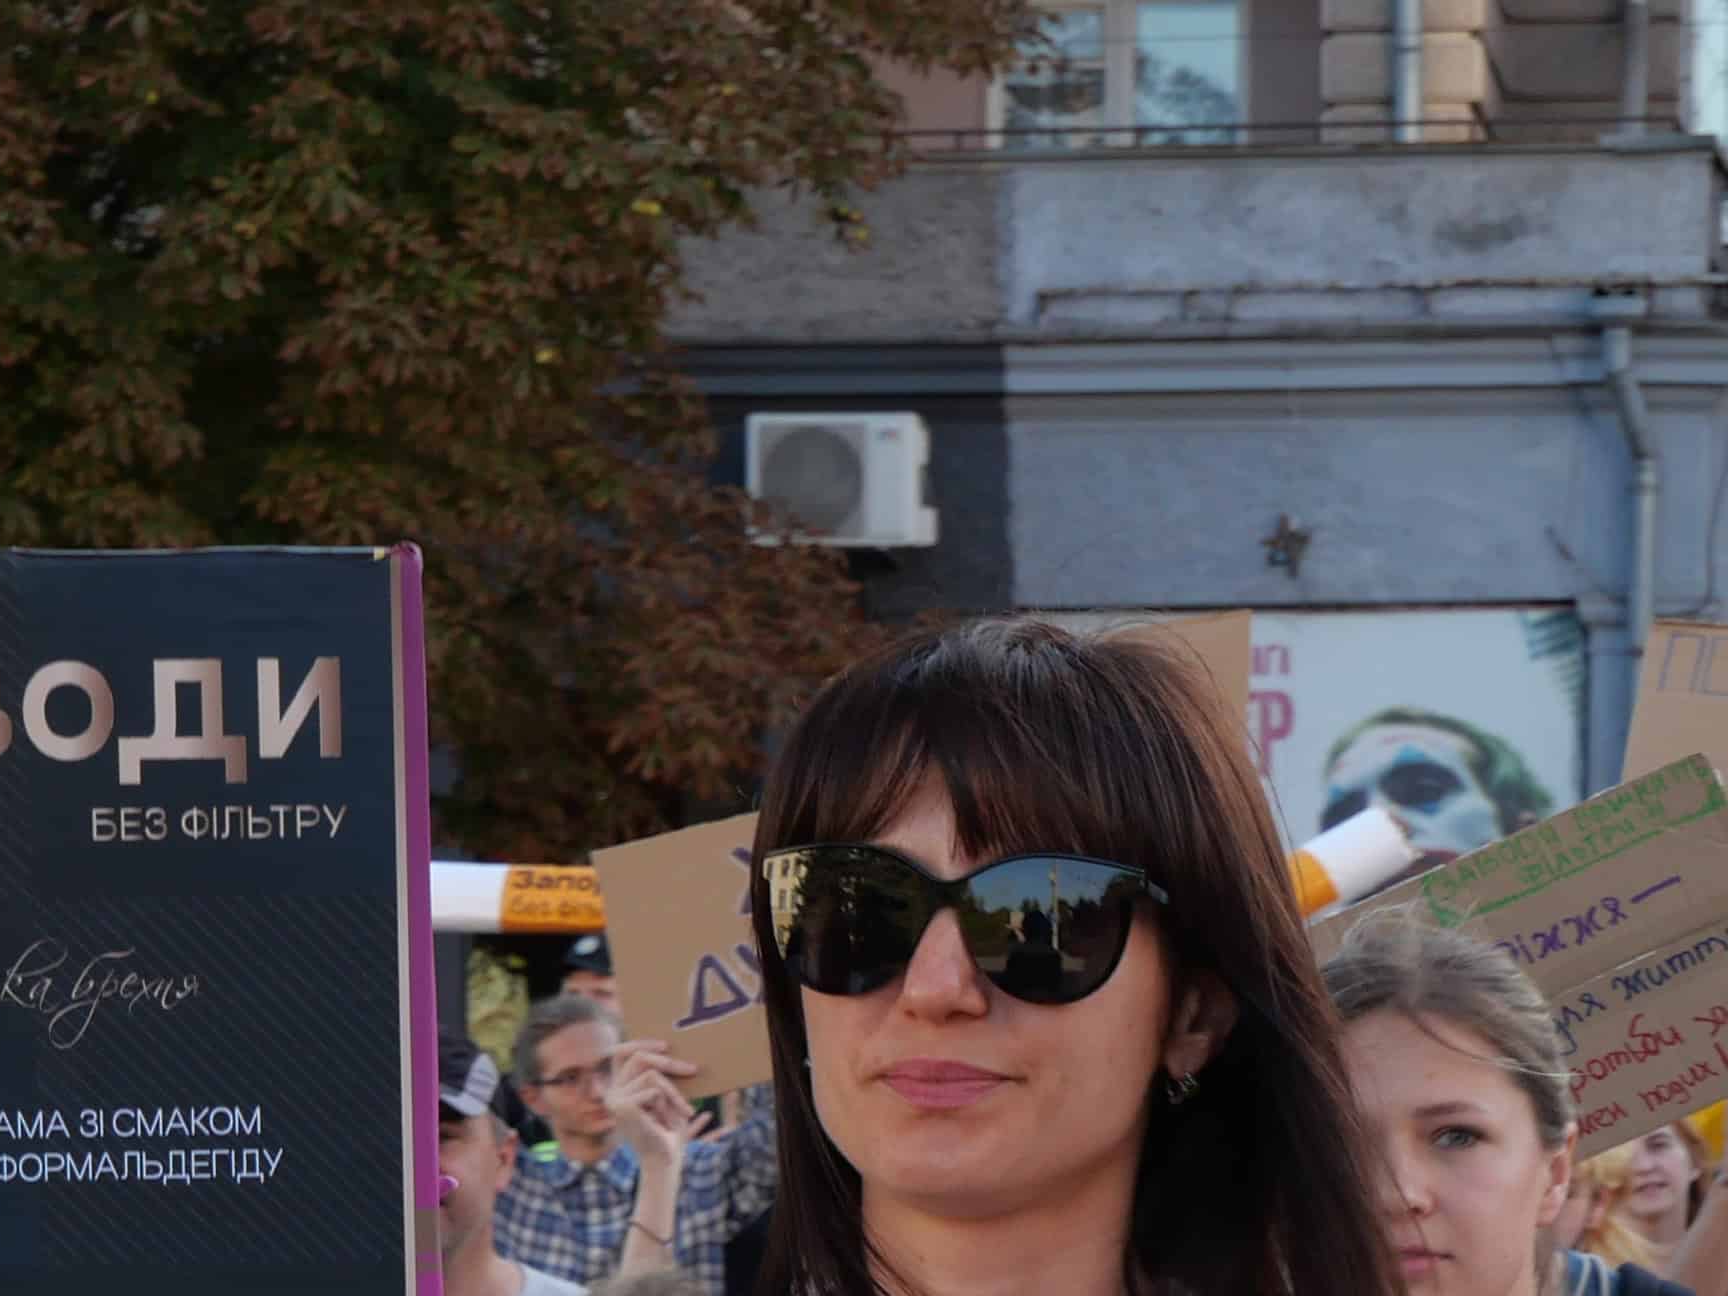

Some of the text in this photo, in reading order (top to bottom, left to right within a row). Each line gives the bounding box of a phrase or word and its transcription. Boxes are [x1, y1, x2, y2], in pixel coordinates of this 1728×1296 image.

[90, 803, 348, 843] БЕЗ ФІЛЬТРУ
[48, 946, 201, 1050] брехня
[79, 1109, 106, 1139] ЗІ
[111, 1106, 264, 1138] СМАКОМ
